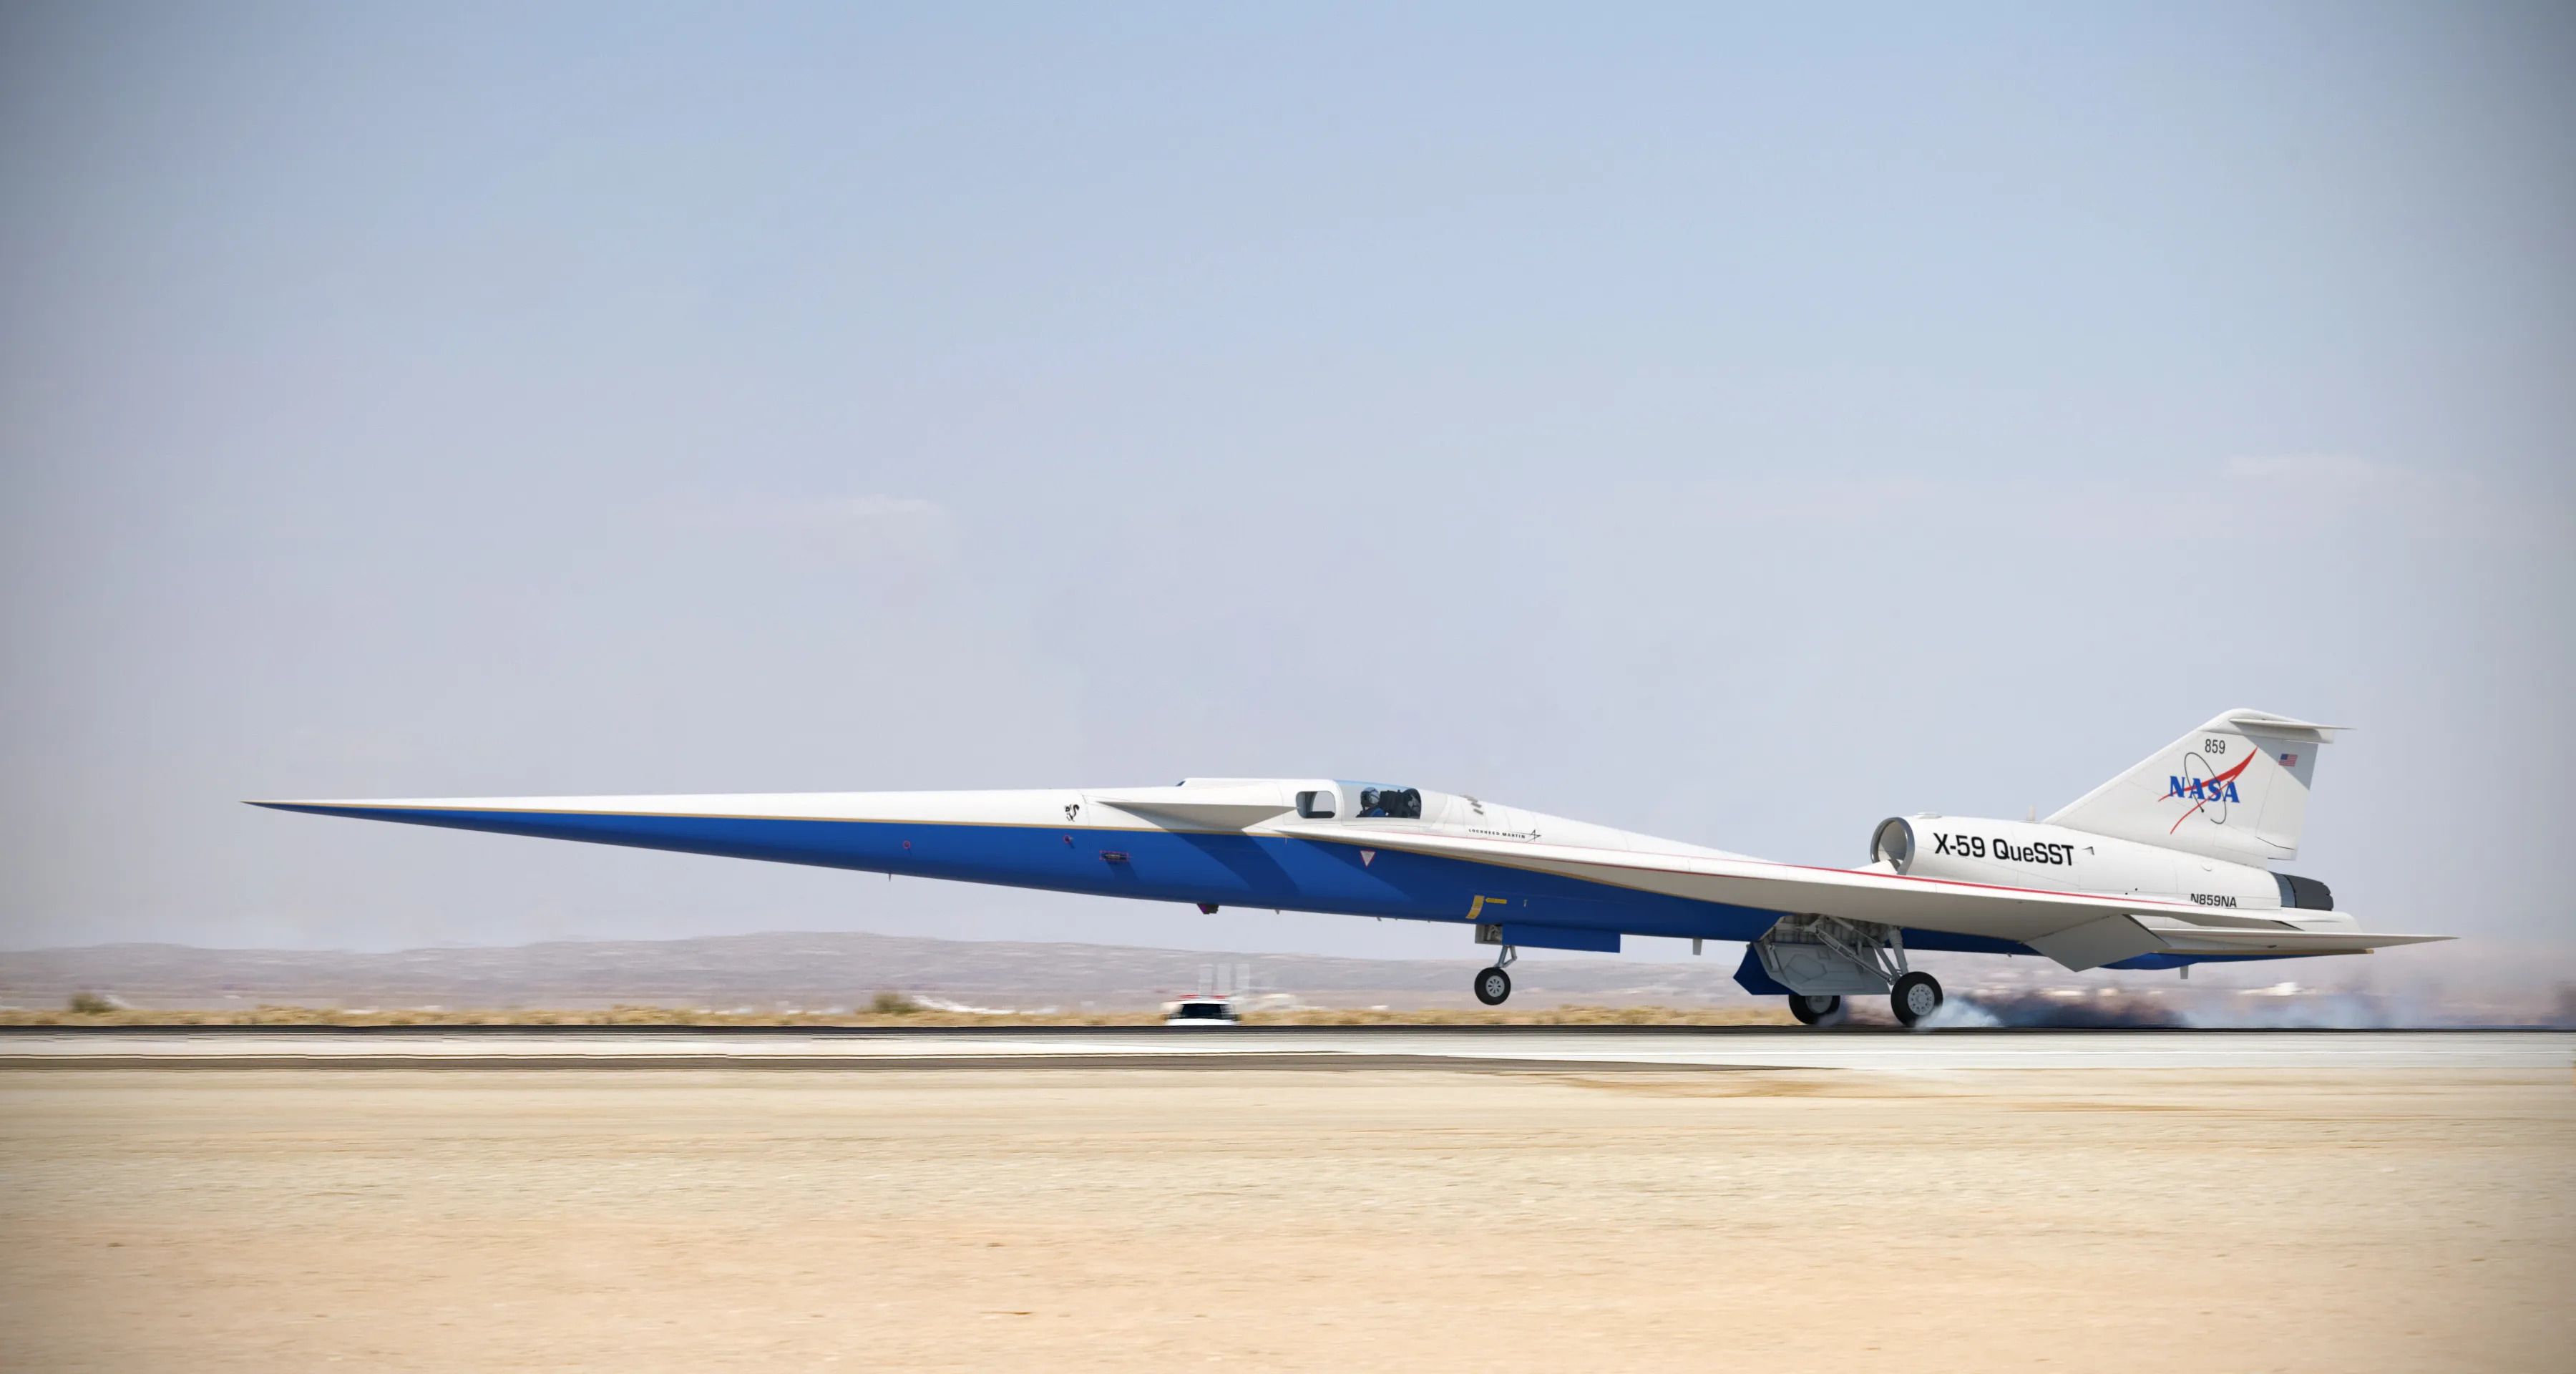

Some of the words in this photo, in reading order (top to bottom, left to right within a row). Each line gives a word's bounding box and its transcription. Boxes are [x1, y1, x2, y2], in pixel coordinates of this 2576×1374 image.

[2205, 739, 2225, 754] 859
[2170, 776, 2240, 803] NASA
[1933, 832, 1986, 858] X-59
[1993, 838, 2074, 866] QueSST
[2190, 893, 2237, 907] N859NA
